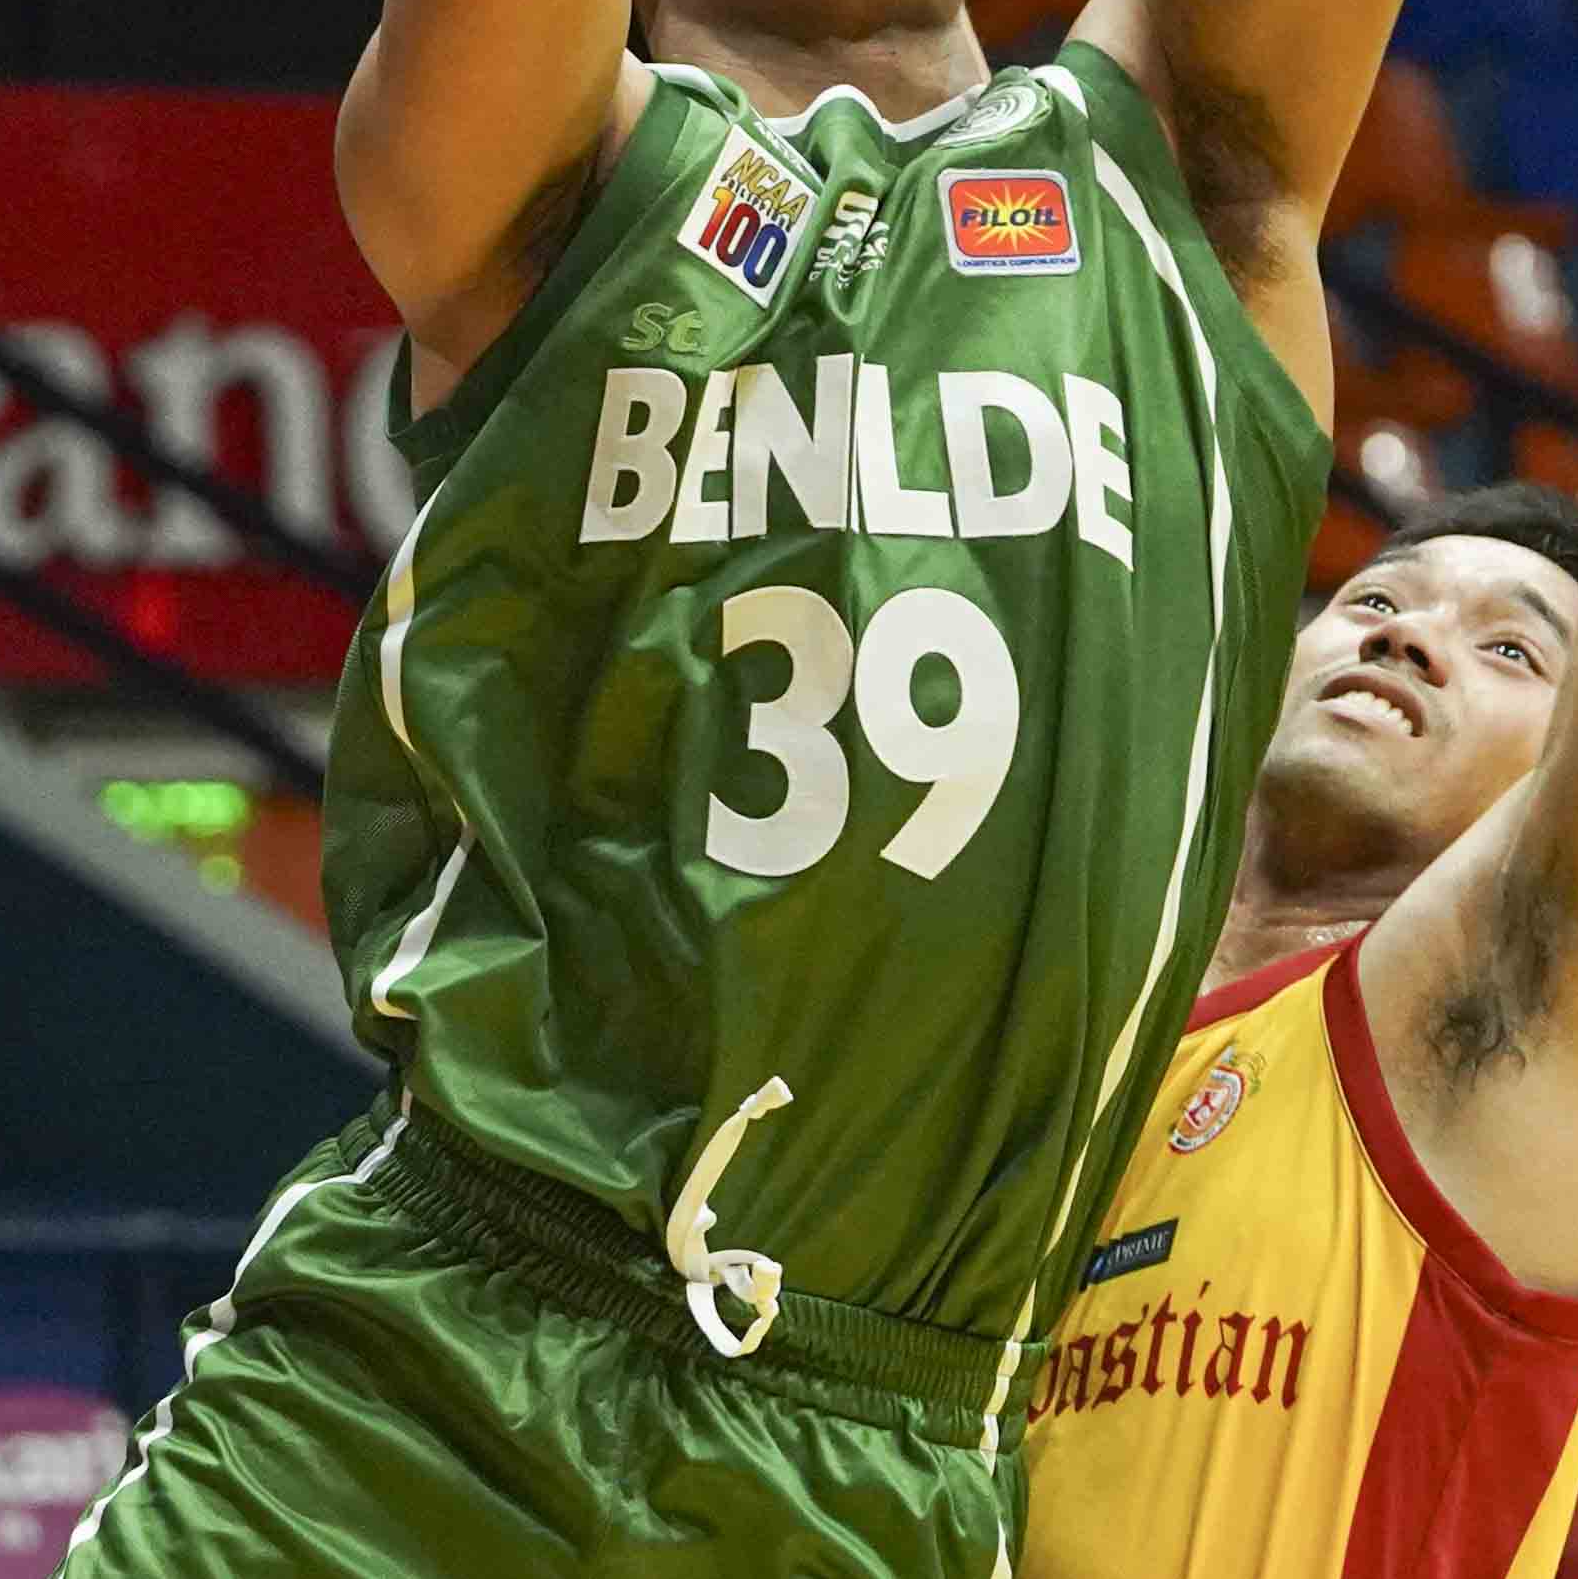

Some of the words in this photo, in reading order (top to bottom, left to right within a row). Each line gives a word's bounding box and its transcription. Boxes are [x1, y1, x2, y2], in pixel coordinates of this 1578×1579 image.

[698, 185, 788, 289] 100
[722, 147, 810, 225] NCAA
[578, 352, 1134, 573] BENLDE
[705, 585, 1021, 881] 39
